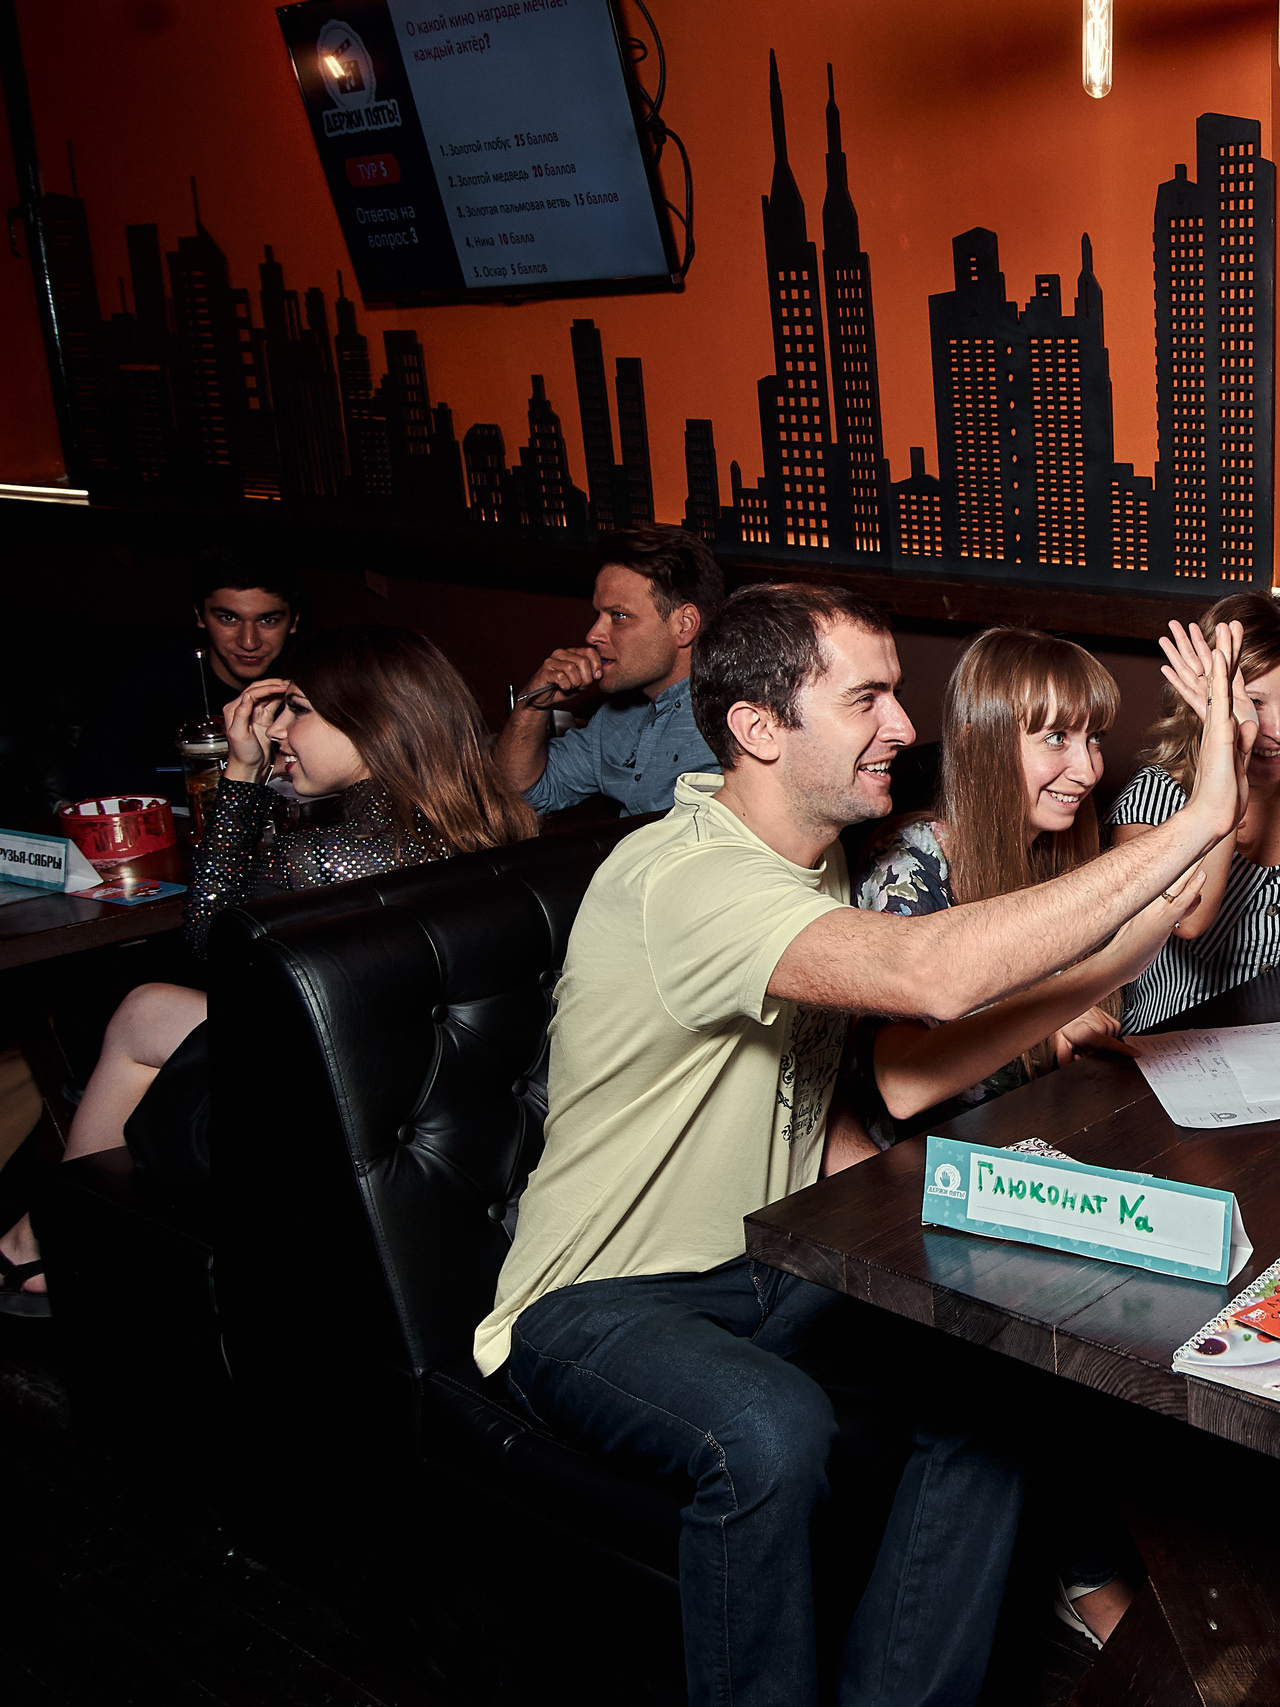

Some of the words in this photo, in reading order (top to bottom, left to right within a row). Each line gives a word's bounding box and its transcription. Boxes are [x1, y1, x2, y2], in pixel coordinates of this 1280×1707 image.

[406, 21, 415, 37] О
[417, 14, 448, 34] какой
[449, 12, 475, 29] кино
[477, 5, 522, 23] награде
[413, 40, 455, 62] каждый
[455, 33, 491, 55] актёр?
[325, 109, 365, 134] ДЕРЖИ
[365, 103, 399, 127] ПЯТЬ!
[439, 145, 449, 157] 1.
[449, 140, 483, 156] Золотой
[484, 136, 512, 151] глобус
[514, 134, 526, 147] 25
[526, 131, 559, 146] баллов
[356, 162, 378, 180] ТУР
[379, 161, 388, 177] 5
[448, 176, 457, 188] 2.
[457, 172, 491, 187] Золотой
[492, 169, 529, 183] медведь
[532, 165, 543, 178] 20
[544, 163, 577, 176] баллов
[356, 207, 398, 224] Ответы
[400, 205, 416, 219] на
[457, 206, 466, 218] 3.
[466, 205, 499, 218] Золотая
[500, 200, 545, 214] пальмовая
[546, 198, 571, 209] ветвь
[573, 193, 585, 206] 15
[586, 191, 619, 205] баллов
[367, 231, 409, 250] вопрос
[410, 227, 419, 244] 3
[466, 237, 474, 248] 4.
[474, 236, 495, 248] Ника
[498, 233, 509, 245] 10
[509, 232, 535, 245] балла
[474, 267, 482, 278] 5.
[483, 265, 507, 279] Оскар
[510, 263, 517, 275] 5
[517, 262, 548, 275] баллов
